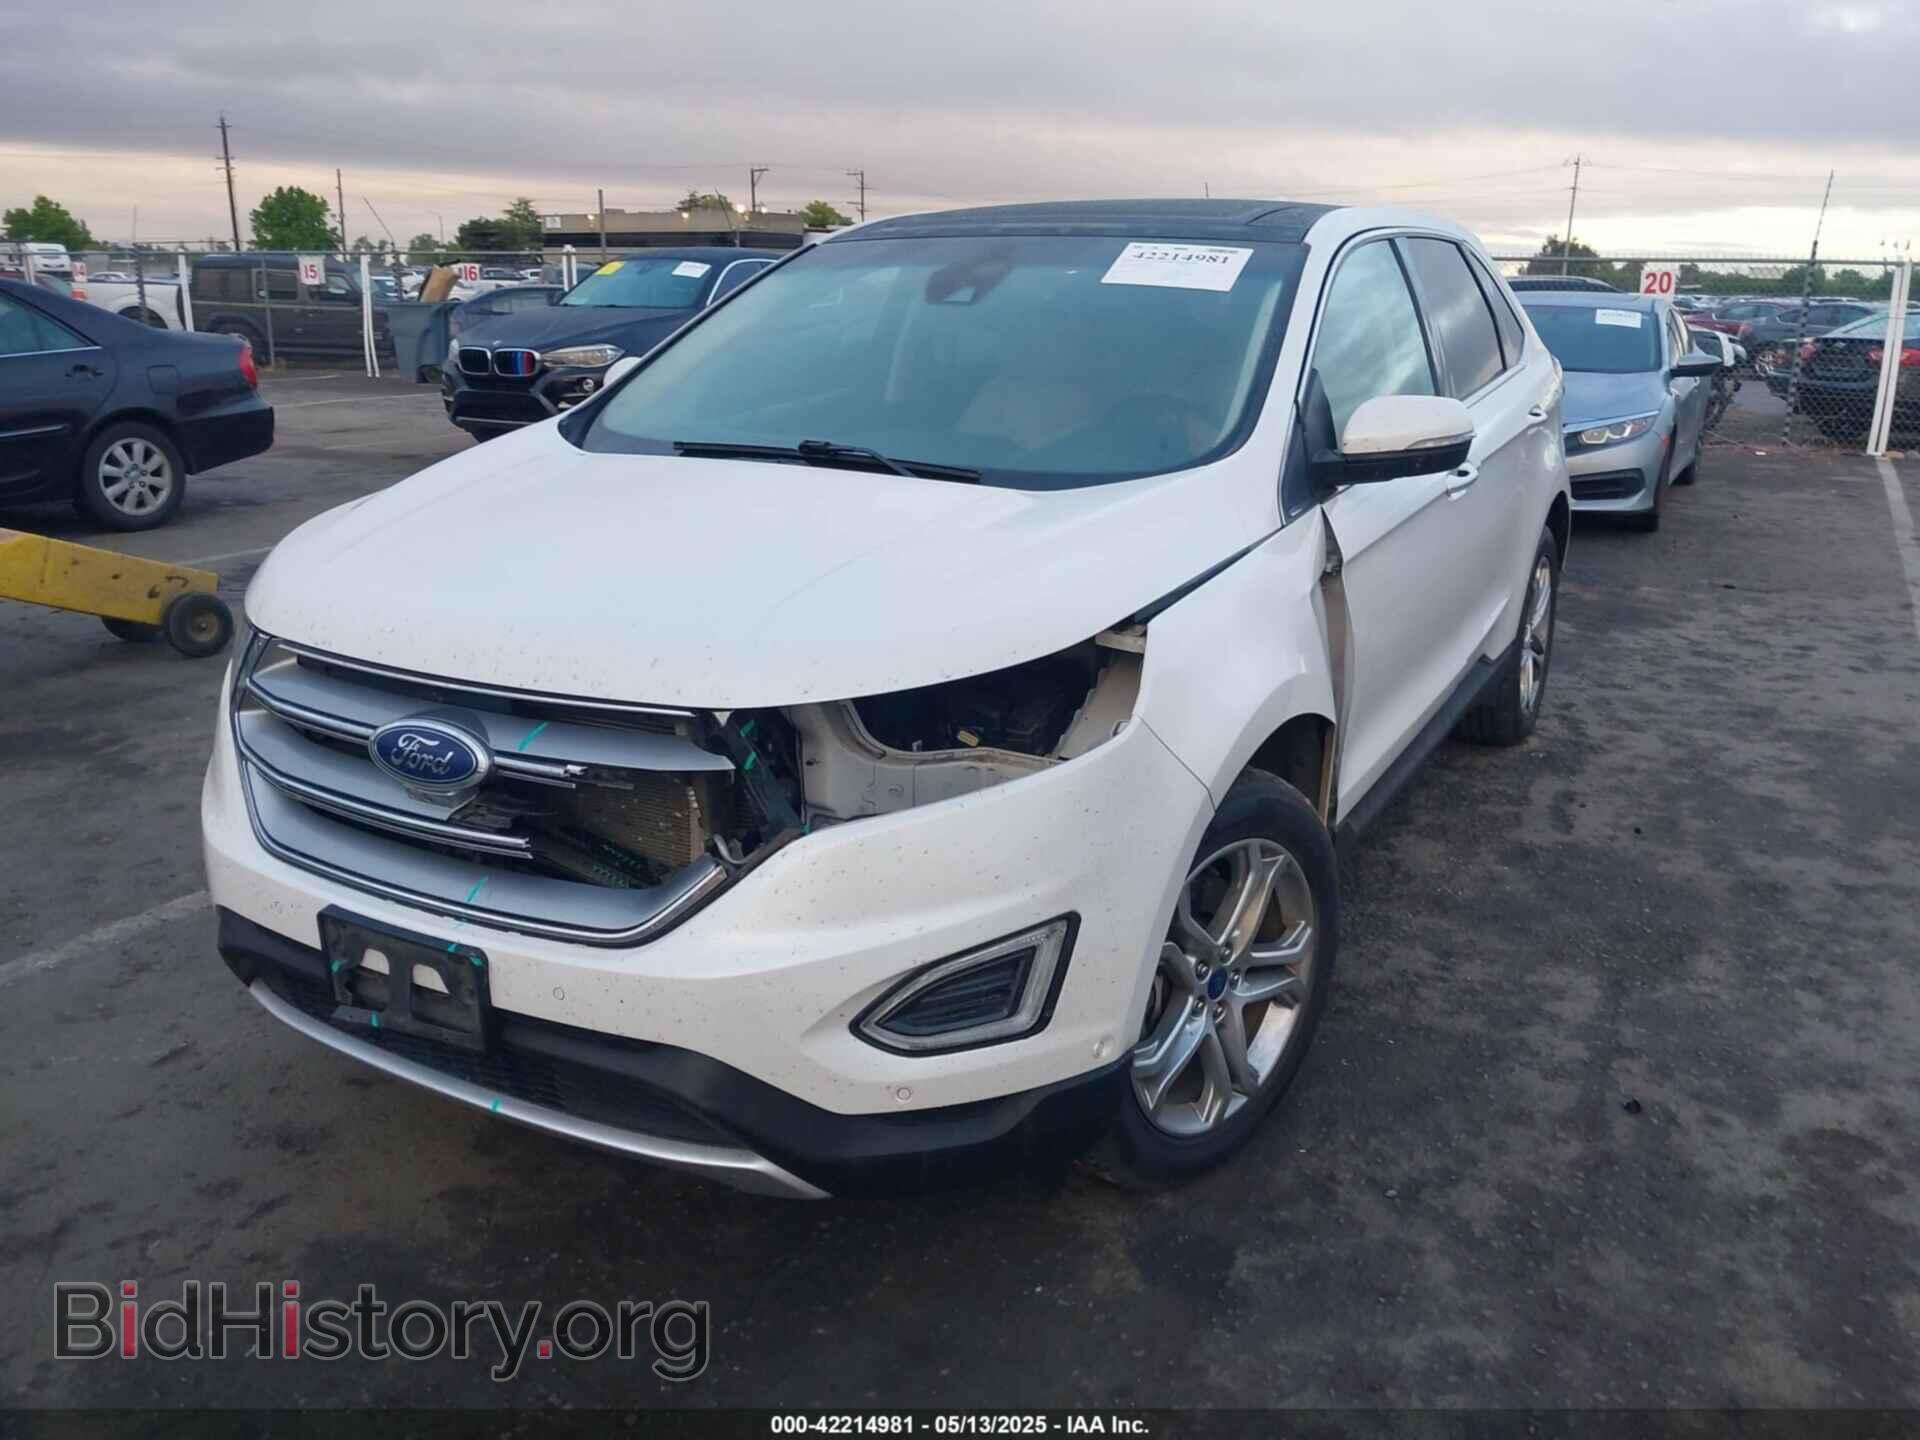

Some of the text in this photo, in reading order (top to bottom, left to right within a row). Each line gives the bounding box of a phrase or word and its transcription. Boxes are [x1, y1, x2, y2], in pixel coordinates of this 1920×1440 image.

[1132, 249, 1230, 265] 42214981
[304, 264, 319, 279] 15
[463, 264, 479, 281] 16
[1643, 271, 1673, 295] 20
[389, 732, 455, 775] Ford
